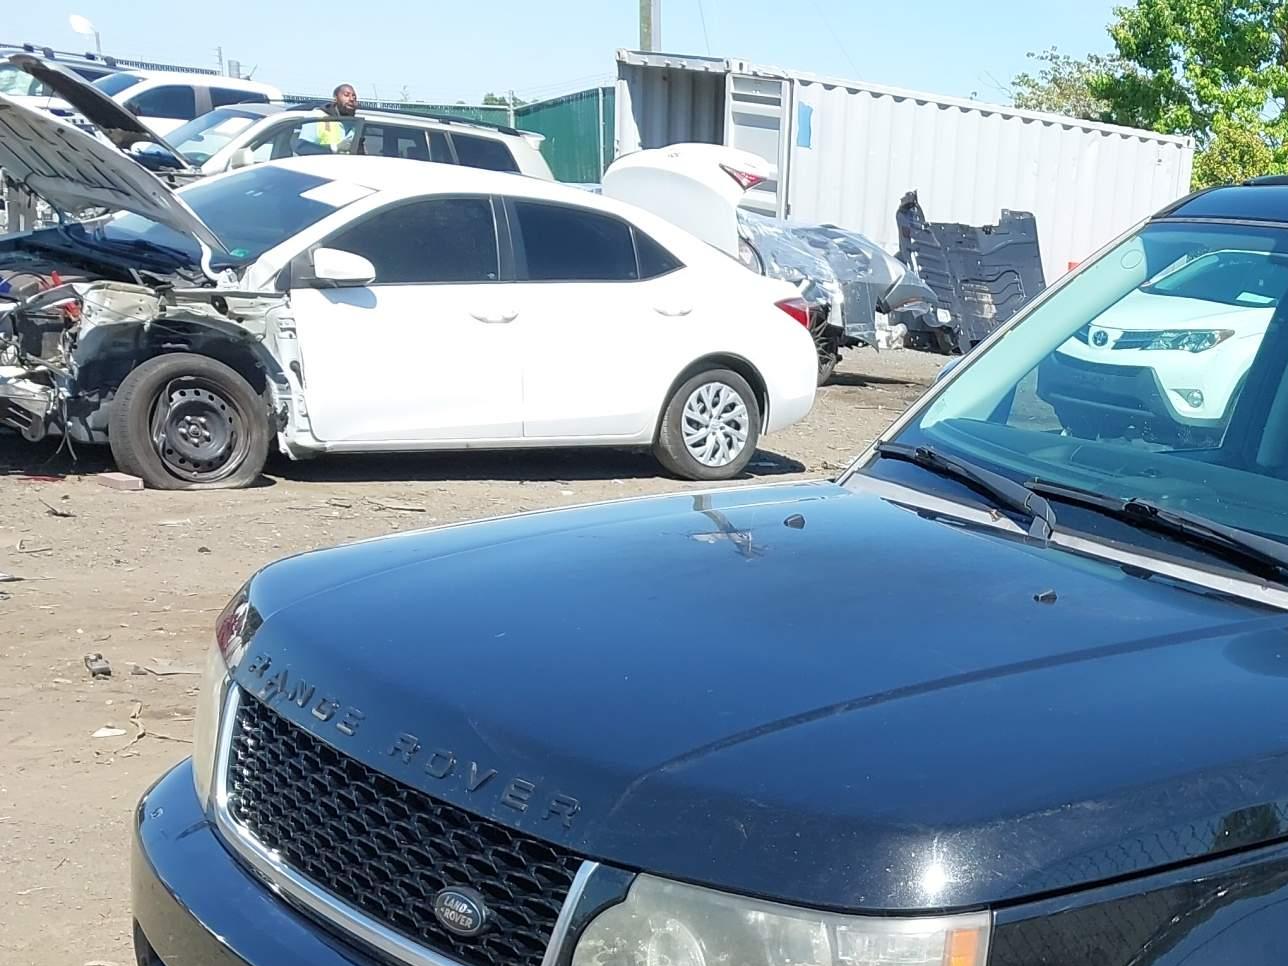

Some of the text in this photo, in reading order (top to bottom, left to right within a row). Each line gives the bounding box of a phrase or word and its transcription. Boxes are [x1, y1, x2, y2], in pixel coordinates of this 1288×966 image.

[248, 653, 582, 830] RANGE ROVER
[443, 895, 468, 914] LAND
[443, 908, 473, 929] ROVER
